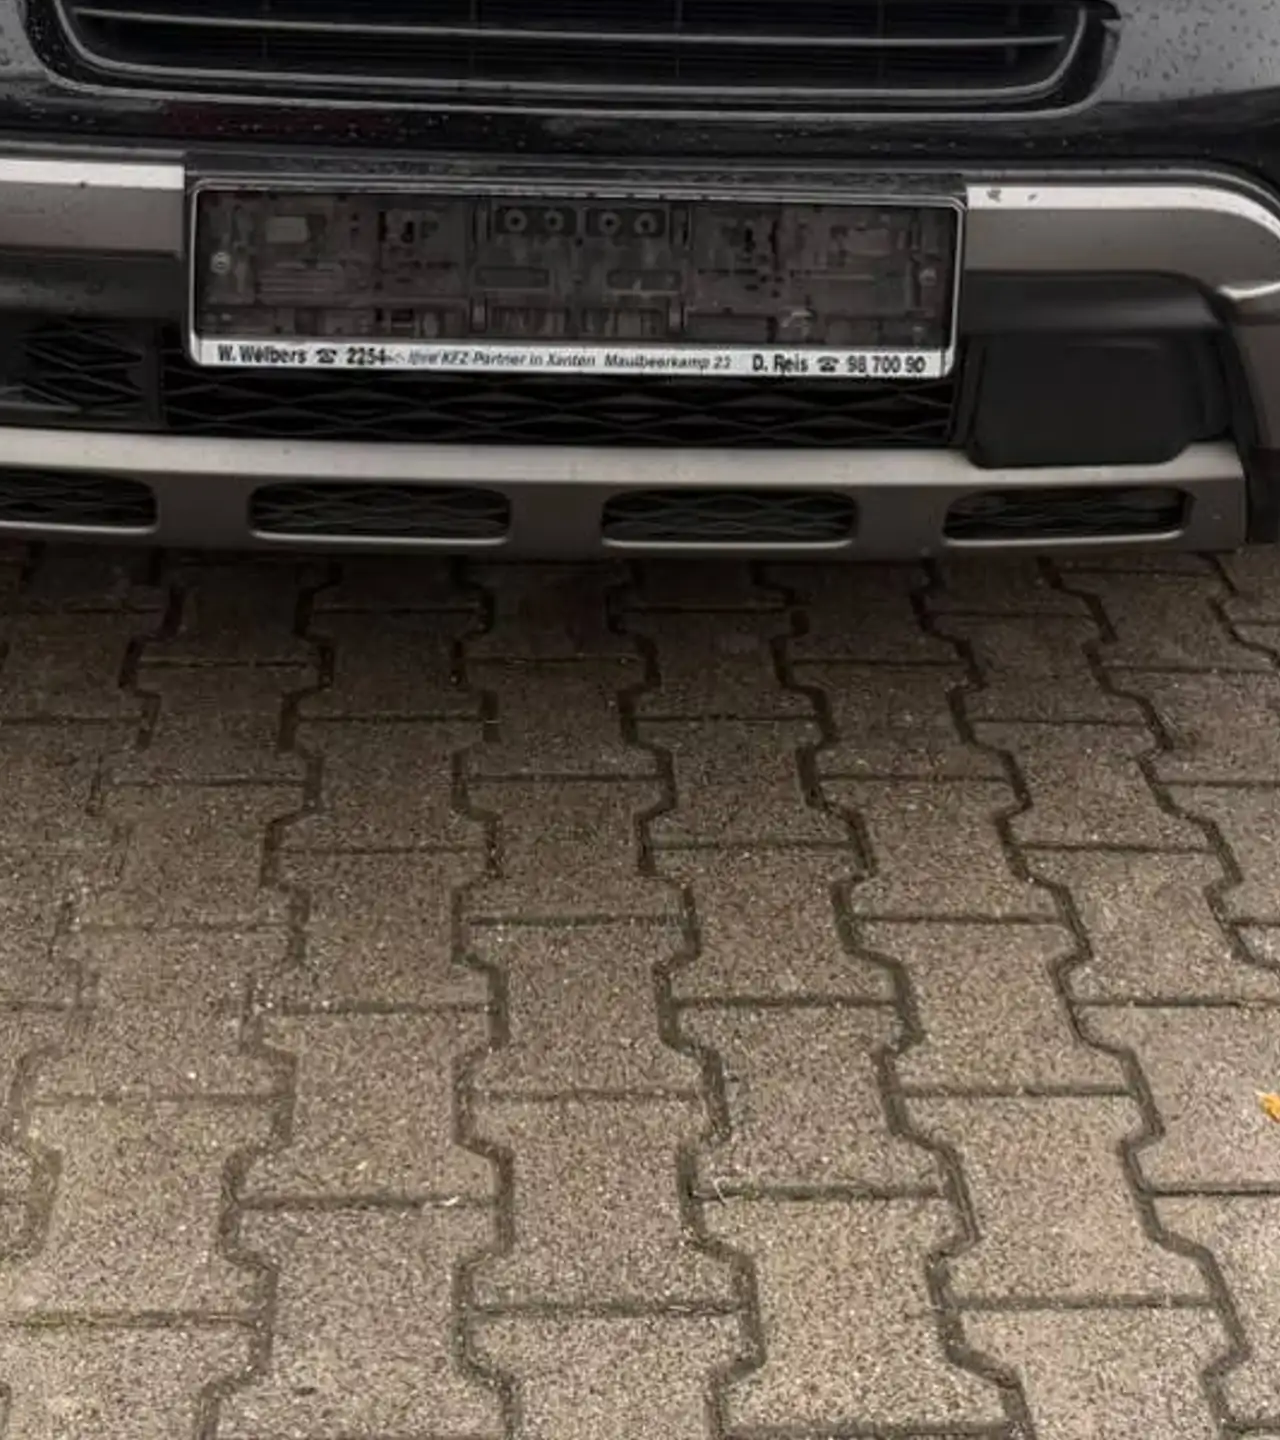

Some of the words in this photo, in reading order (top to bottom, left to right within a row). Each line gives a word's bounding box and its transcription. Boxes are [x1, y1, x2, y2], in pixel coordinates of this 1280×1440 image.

[529, 351, 543, 366] in
[753, 353, 768, 372] D.
[774, 353, 809, 372] Reis
